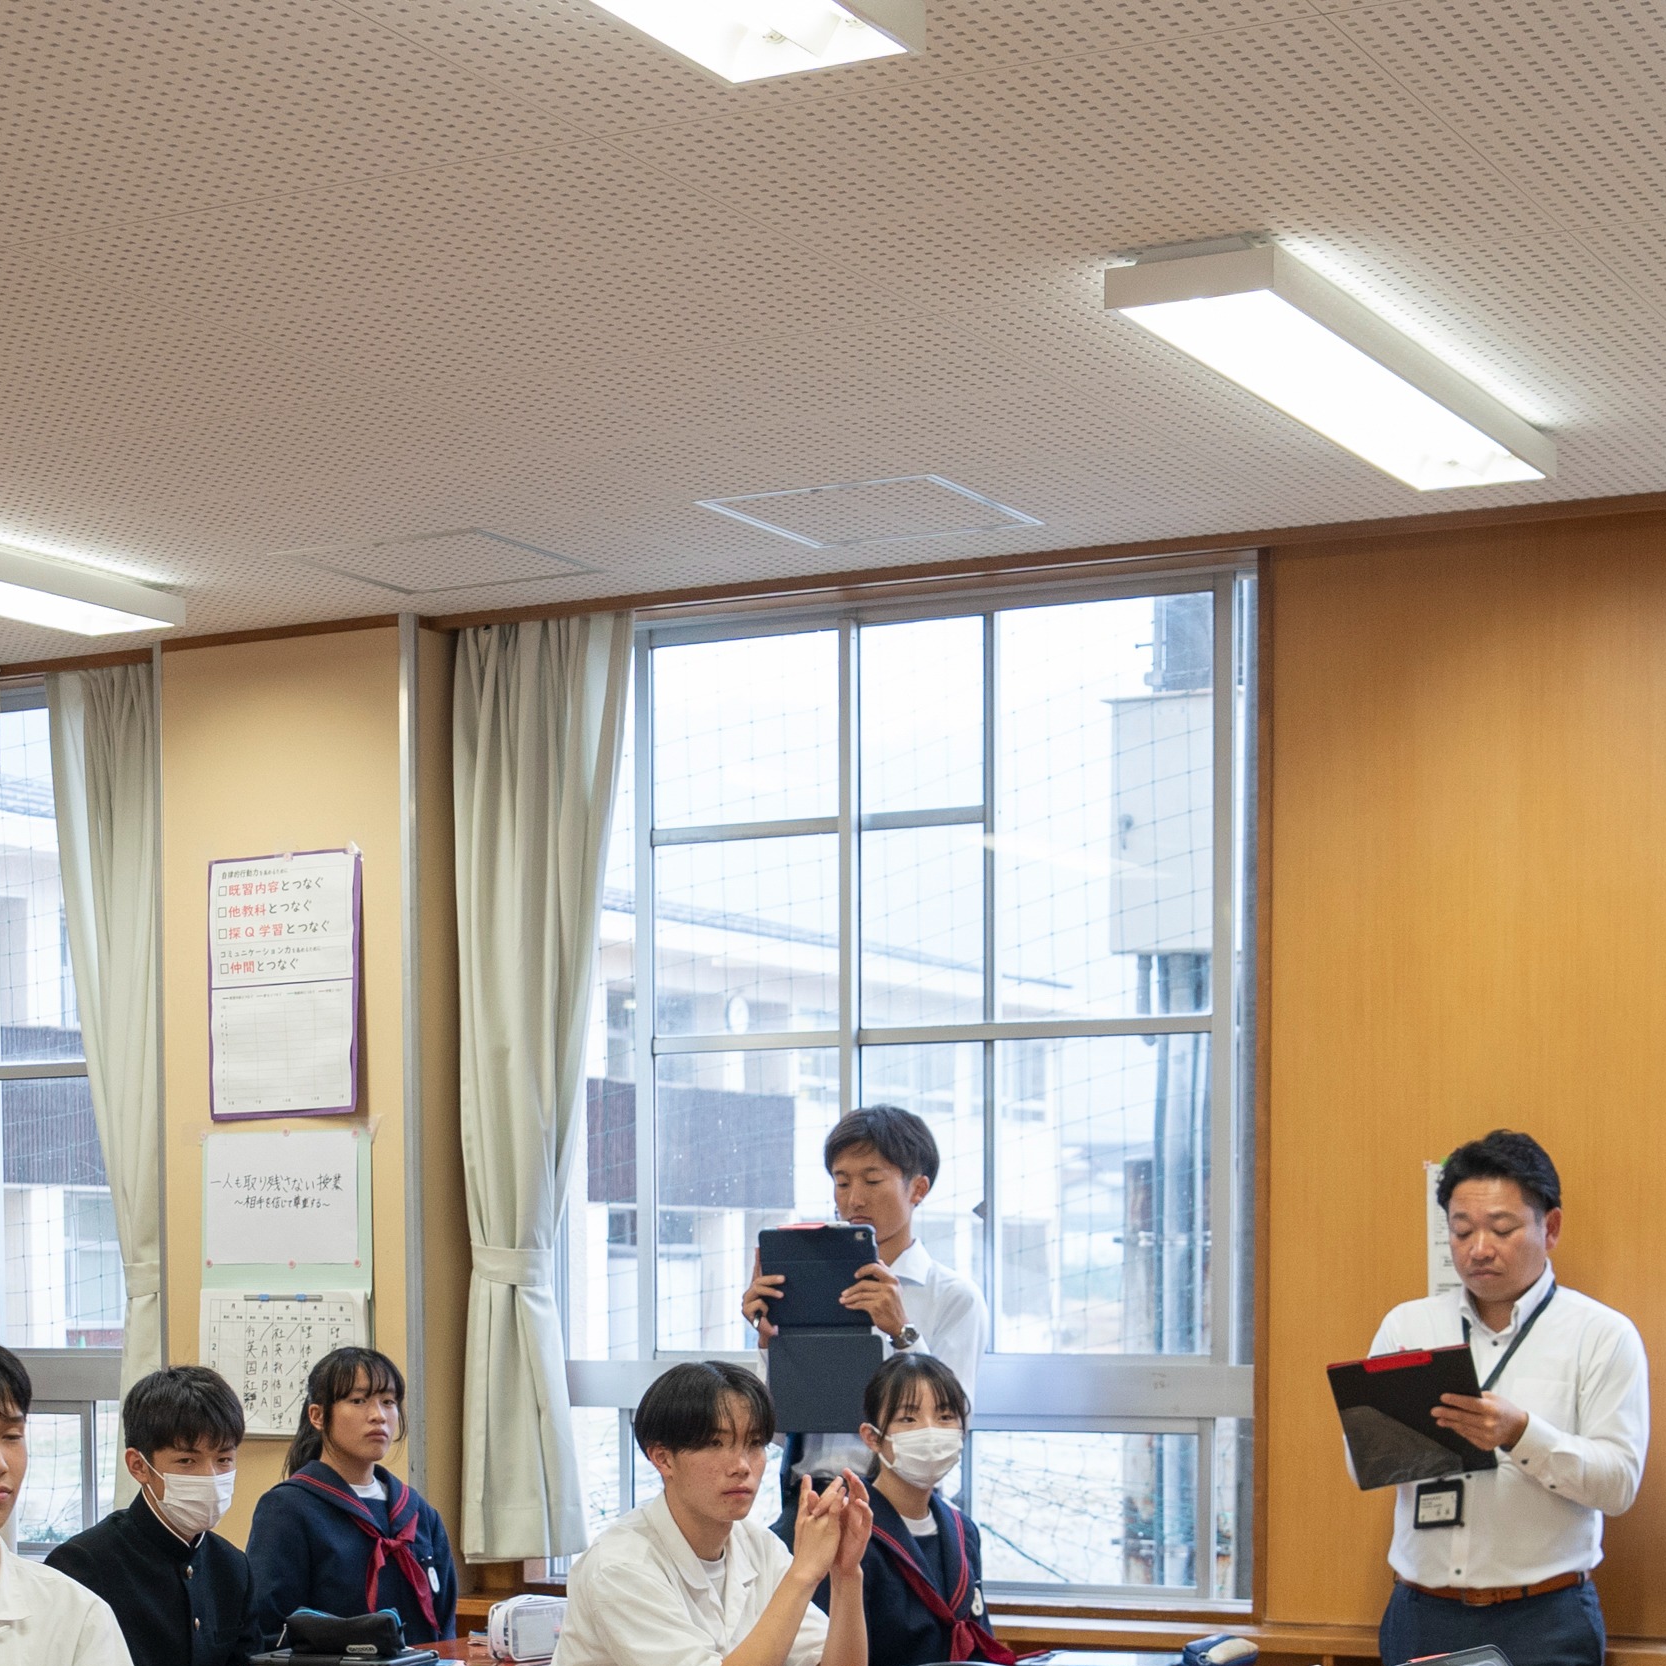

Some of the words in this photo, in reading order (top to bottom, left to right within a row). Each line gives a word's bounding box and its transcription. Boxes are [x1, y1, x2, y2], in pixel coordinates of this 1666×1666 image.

[228, 876, 324, 896] 既習内容とつなぐ
[228, 899, 312, 918] 他教科とつなぐ
[230, 958, 298, 974] 仲間とつなぐ
[210, 1172, 343, 1193] 一人も取り残さない授業
[212, 1343, 217, 1351] 2
[245, 1341, 258, 1359] 英
[261, 1345, 268, 1357] A
[274, 1343, 283, 1357] 英
[245, 1360, 257, 1375] 国
[262, 1361, 268, 1371] A
[261, 1380, 268, 1392] B
[261, 1397, 268, 1407] A
